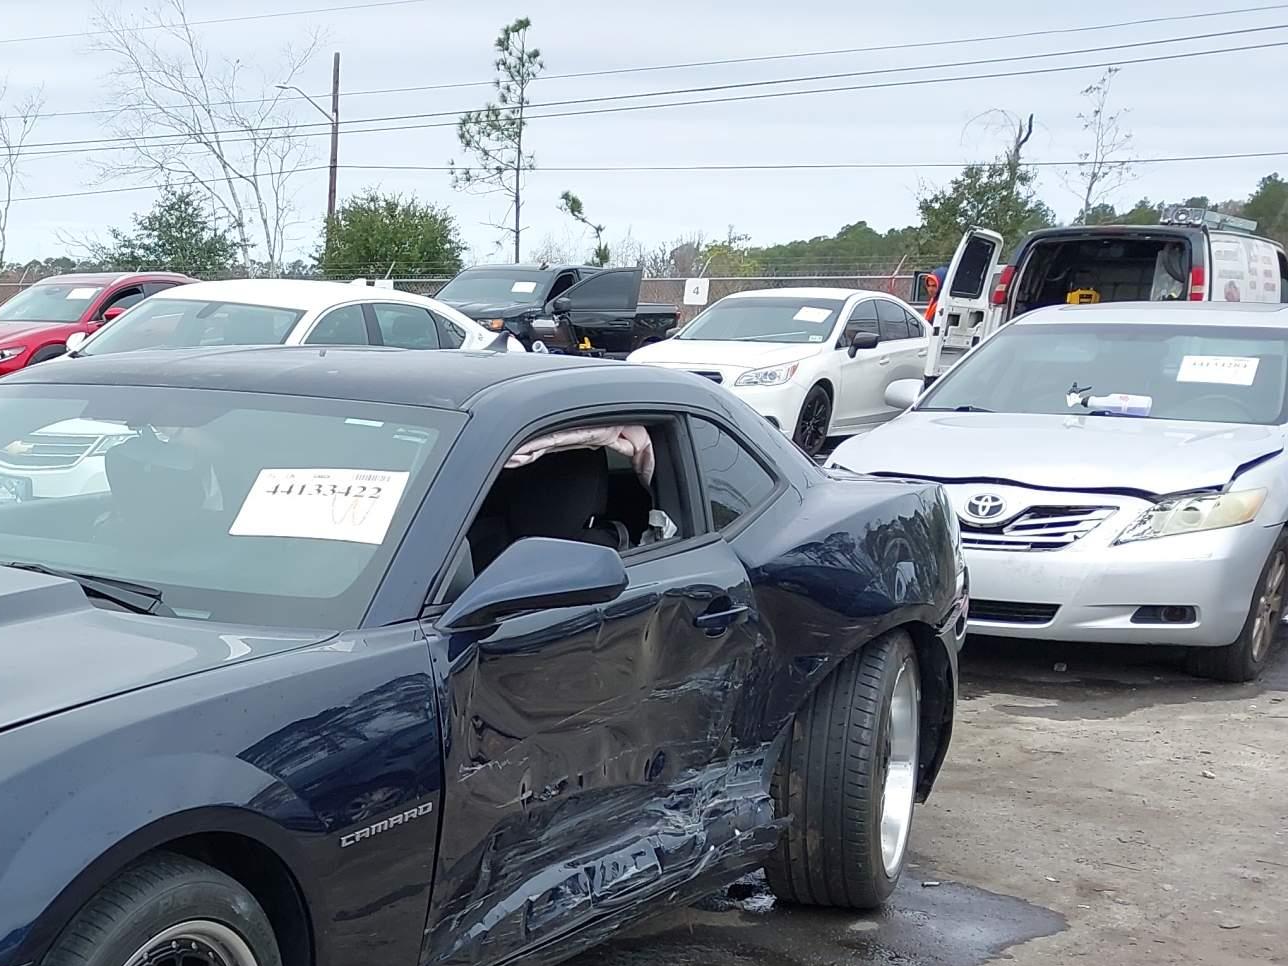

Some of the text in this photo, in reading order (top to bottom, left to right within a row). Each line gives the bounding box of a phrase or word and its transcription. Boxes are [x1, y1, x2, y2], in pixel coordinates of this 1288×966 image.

[692, 286, 700, 295] 4
[265, 483, 384, 500] 44133422
[339, 801, 434, 849] CAMARO
